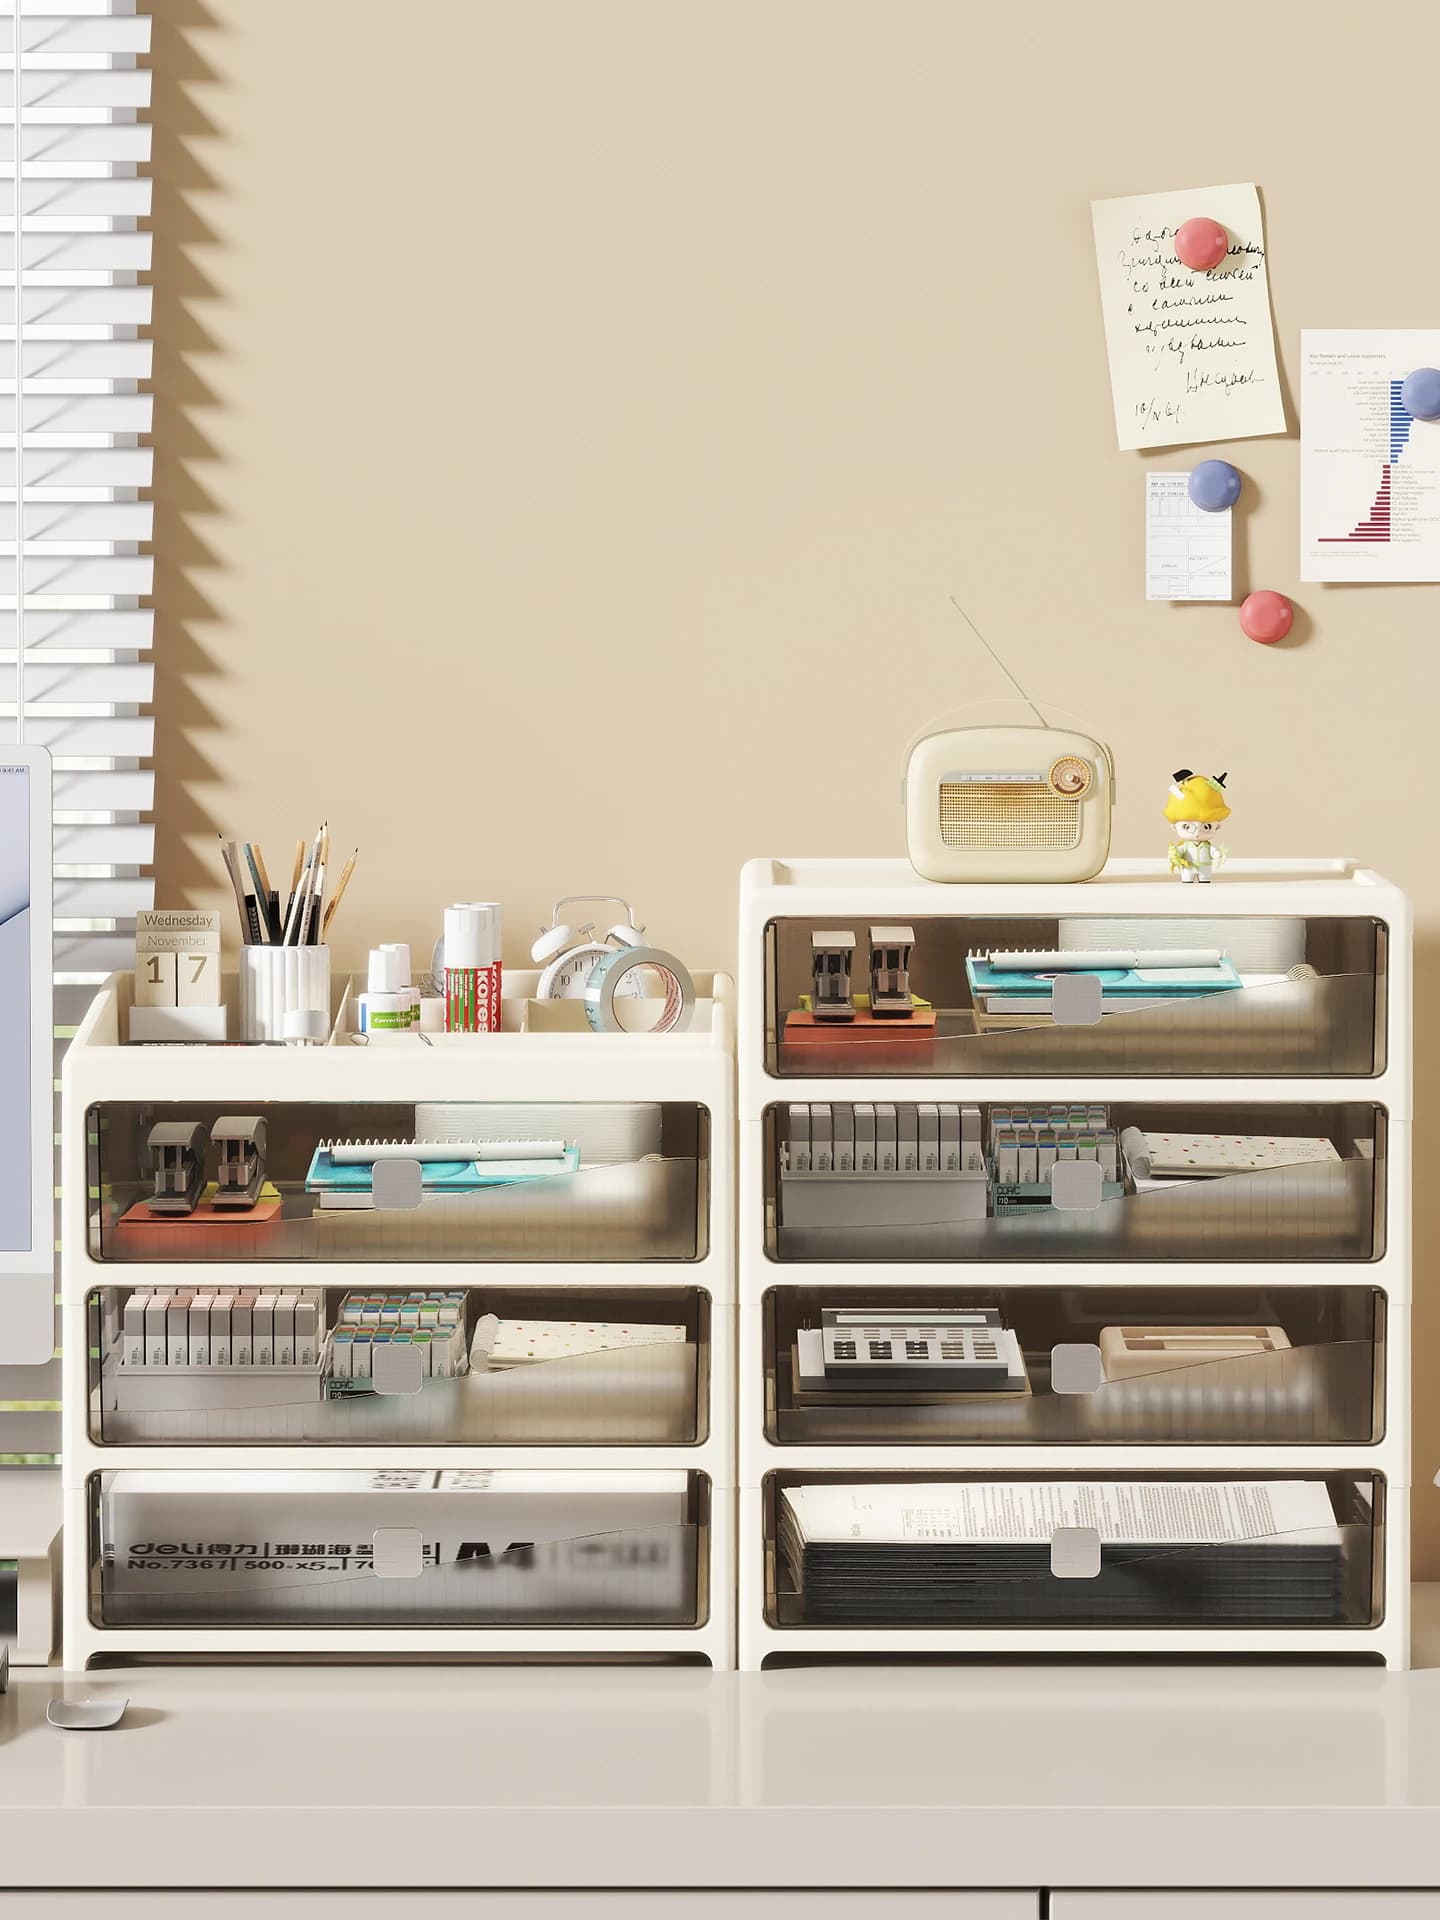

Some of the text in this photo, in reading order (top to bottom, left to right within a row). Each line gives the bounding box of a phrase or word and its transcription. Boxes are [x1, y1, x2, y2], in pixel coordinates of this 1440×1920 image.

[144, 914, 213, 929] Wednesday
[147, 935, 207, 946] November
[574, 960, 583, 972] 11
[560, 975, 571, 986] 10
